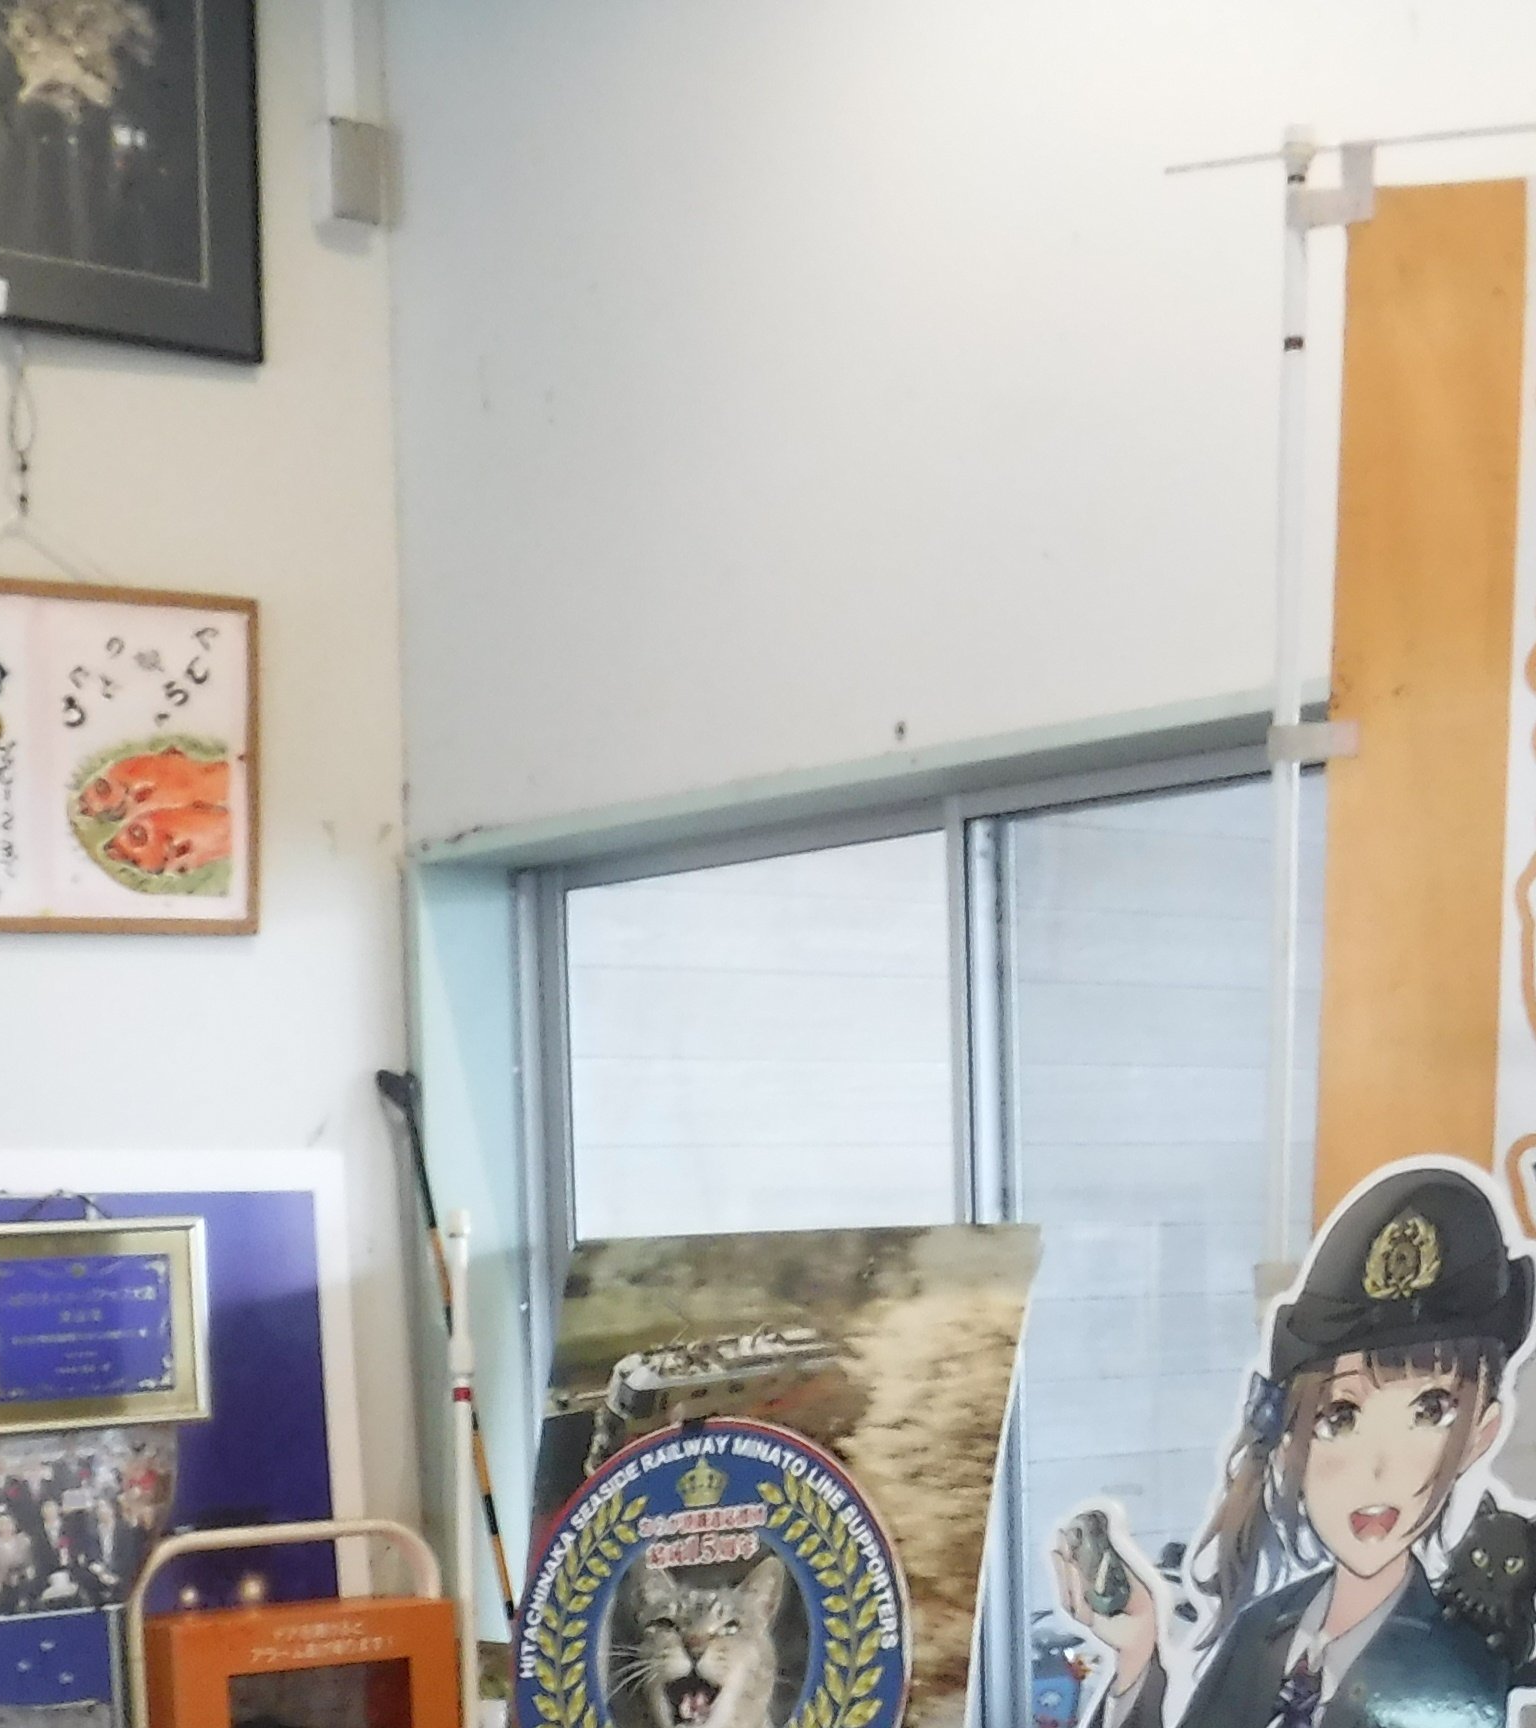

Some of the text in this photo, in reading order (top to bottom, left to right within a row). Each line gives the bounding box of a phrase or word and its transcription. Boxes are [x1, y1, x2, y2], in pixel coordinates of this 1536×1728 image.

[520, 1532, 577, 1678] HITACHINAKA
[570, 1460, 642, 1531] SEASIDE
[640, 1434, 730, 1473] RAILWAY
[731, 1436, 808, 1478] MINATO
[806, 1466, 848, 1511] LINE
[841, 1504, 899, 1649] SUPPORTERS
